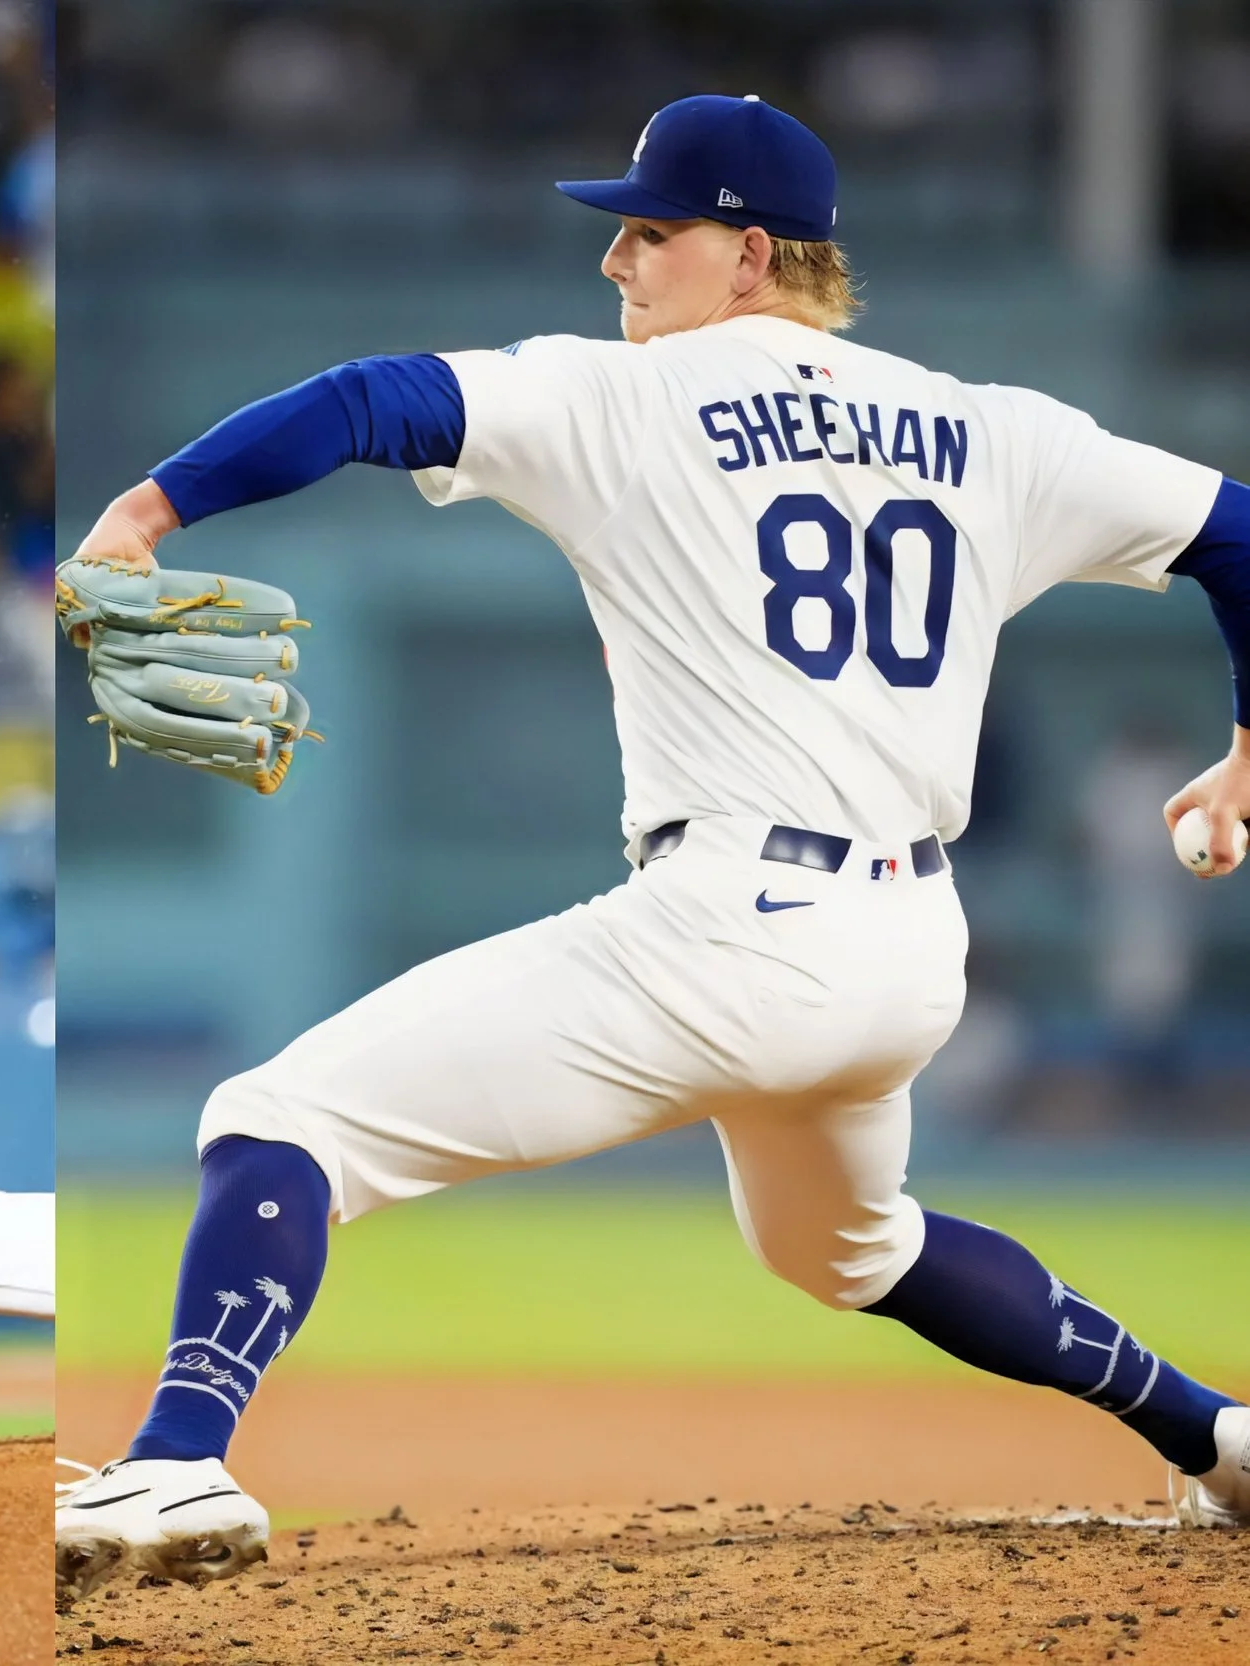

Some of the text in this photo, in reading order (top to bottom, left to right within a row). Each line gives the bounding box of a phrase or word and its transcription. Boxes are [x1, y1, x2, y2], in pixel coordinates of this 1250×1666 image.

[698, 392, 968, 488] SHEEHAN
[756, 493, 957, 688] 80
[178, 1352, 250, 1402] Dodgers
